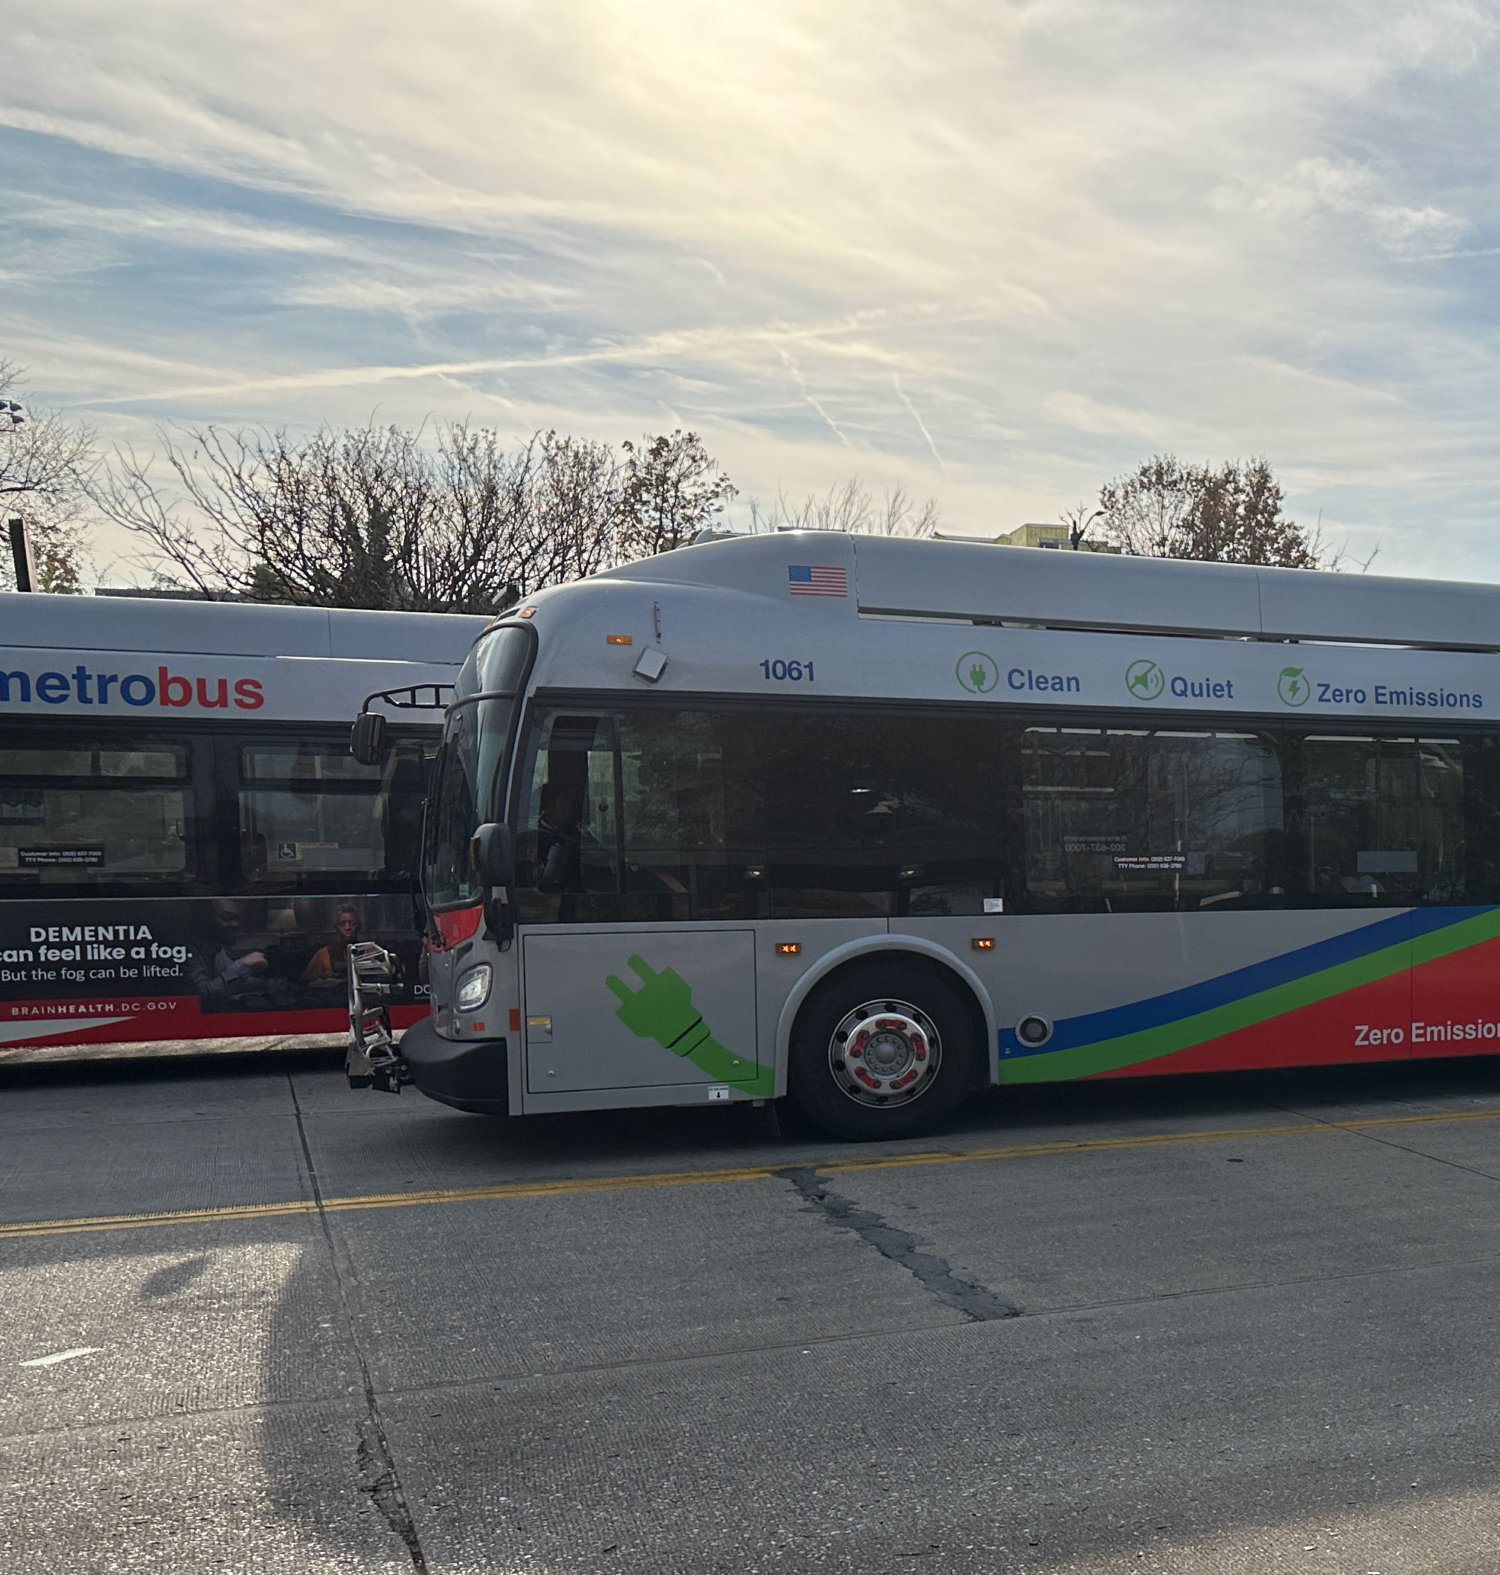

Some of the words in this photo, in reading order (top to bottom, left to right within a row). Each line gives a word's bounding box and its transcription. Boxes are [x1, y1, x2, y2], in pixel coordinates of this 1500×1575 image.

[760, 659, 815, 682] 1061
[1007, 668, 1081, 693] Clean
[1170, 676, 1234, 699] Quiet
[1316, 683, 1367, 704] Zero
[1374, 685, 1483, 709] Emissions
[30, 925, 153, 943] DEMENTIA
[0, 949, 34, 963] an
[39, 944, 81, 962] feel
[86, 943, 126, 960] like
[130, 947, 145, 960] a
[151, 942, 193, 963] fog.
[1, 969, 27, 982] But
[31, 967, 57, 980] the
[61, 967, 86, 982] fog
[89, 969, 115, 979] can
[120, 966, 138, 978] be
[143, 964, 184, 978] lifted.
[11, 1001, 177, 1016] BRAINHEALTH.DC.GOV
[1354, 1025, 1404, 1046] Zero
